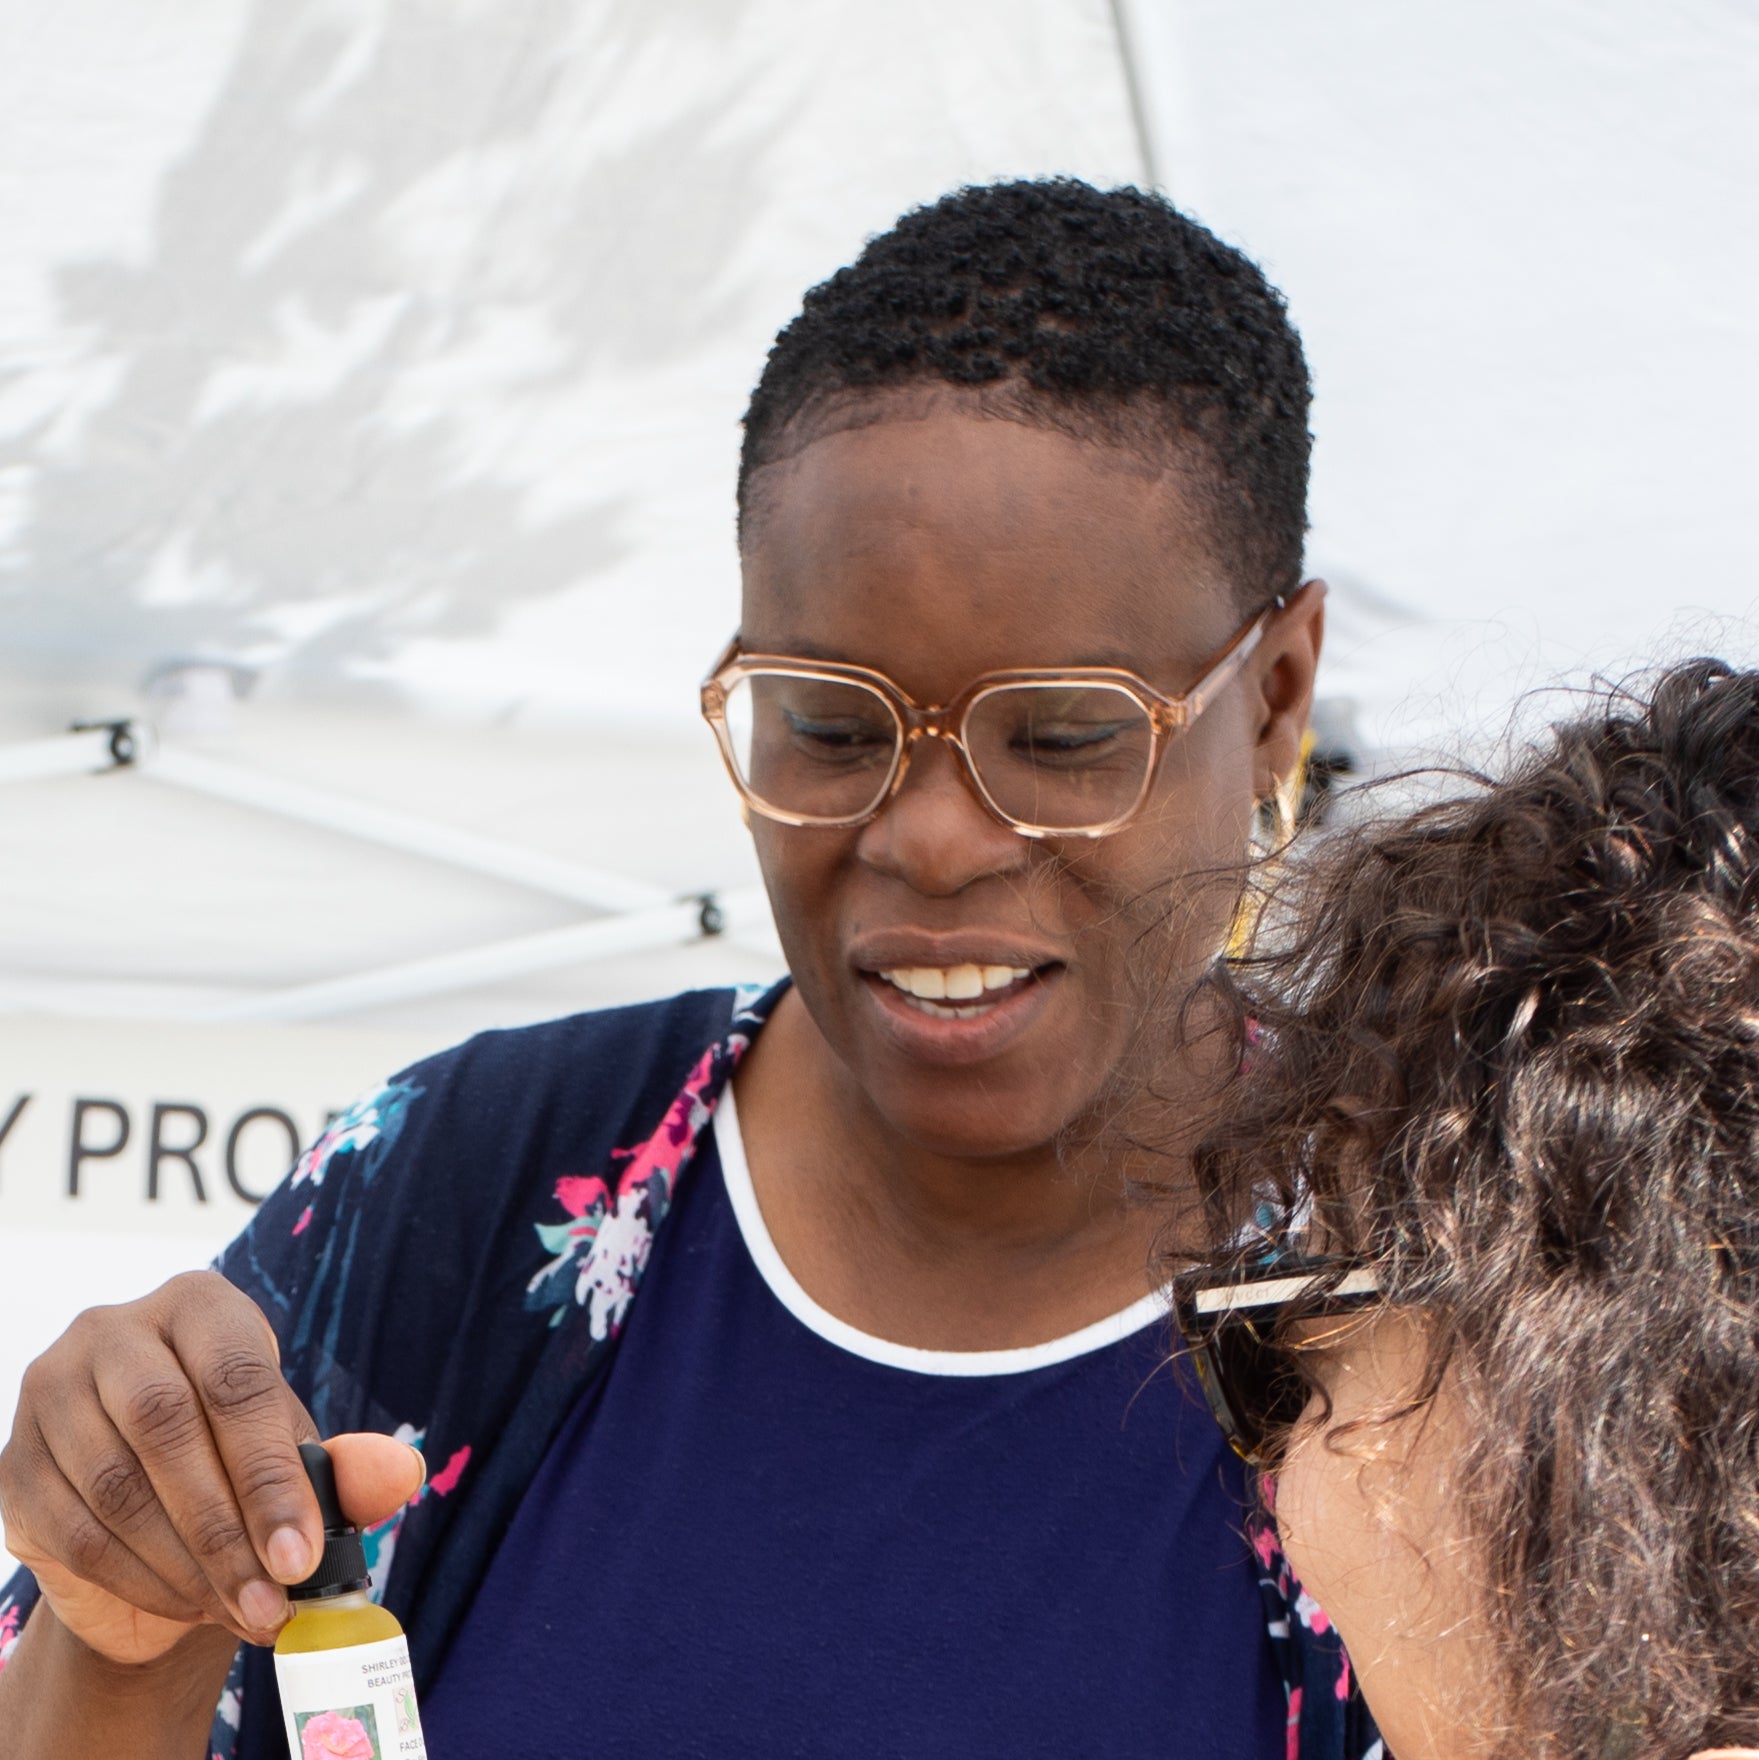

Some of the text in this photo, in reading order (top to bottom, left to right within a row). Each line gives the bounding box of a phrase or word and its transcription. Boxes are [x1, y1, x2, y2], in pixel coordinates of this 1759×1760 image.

[67, 1097, 343, 1205] PRO
[361, 1658, 398, 1674] SHIRLEY
[368, 1673, 401, 1688] BEAUTY
